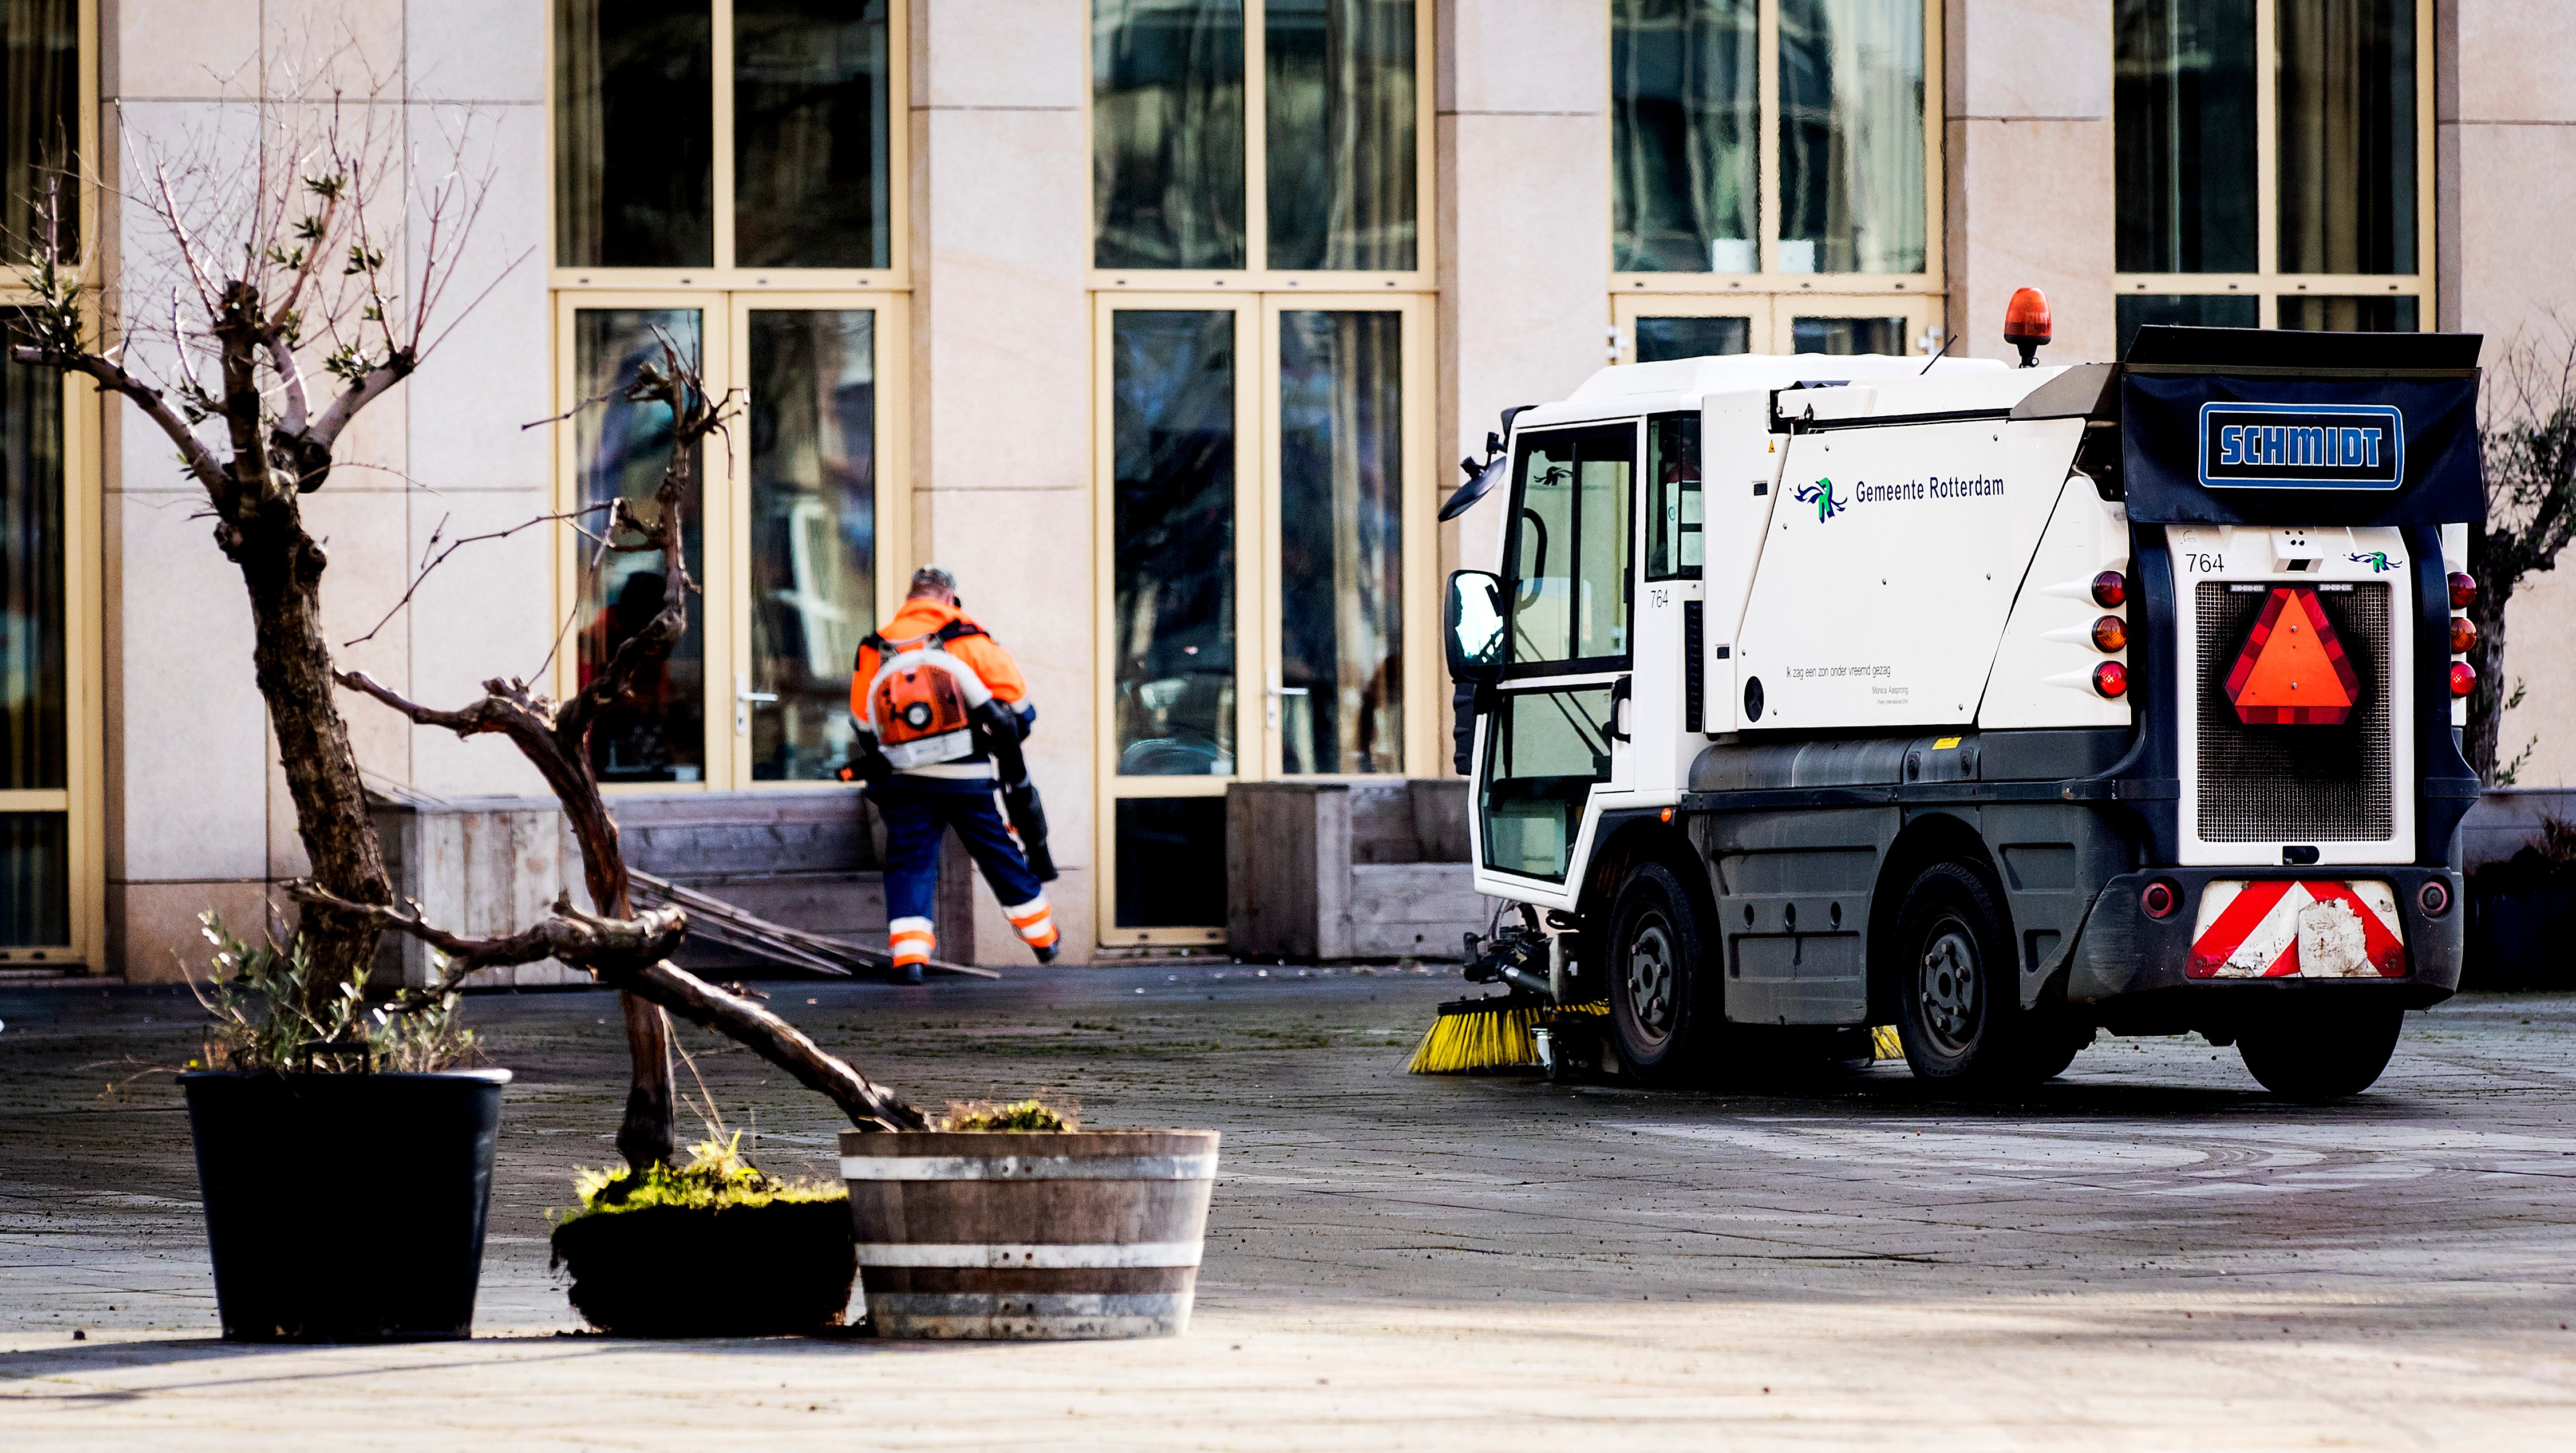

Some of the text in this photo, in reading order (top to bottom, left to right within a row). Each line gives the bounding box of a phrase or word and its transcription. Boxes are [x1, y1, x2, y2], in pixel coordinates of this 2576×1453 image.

[2221, 425, 2383, 467] SCHMIDT
[1856, 474, 2004, 503] Gemeente Rotterdam
[2186, 554, 2225, 572] 764
[1651, 589, 1668, 609] 764
[1787, 664, 1891, 680] Ik zag een zon onder vreemd gezag
[1872, 686, 1887, 694] Monica
